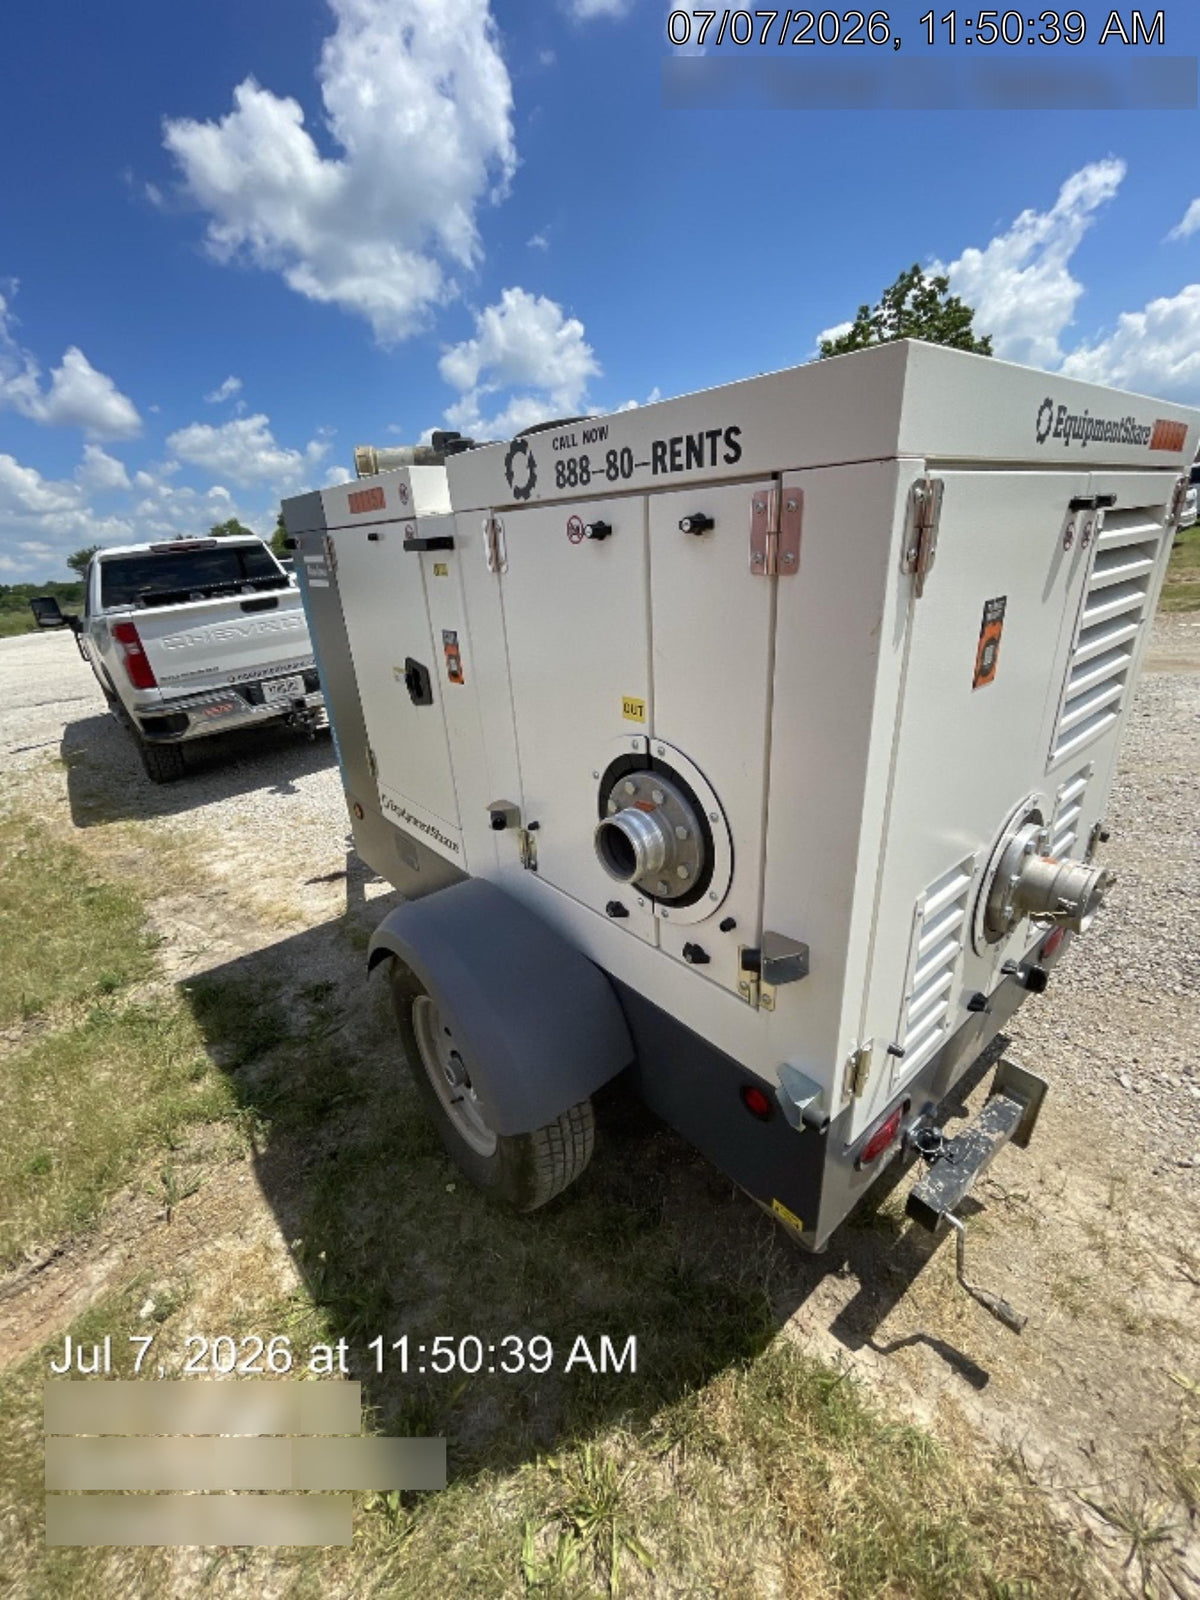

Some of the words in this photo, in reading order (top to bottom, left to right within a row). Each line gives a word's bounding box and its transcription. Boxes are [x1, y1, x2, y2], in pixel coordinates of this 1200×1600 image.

[552, 431, 578, 451] CALL
[582, 424, 609, 445] NOW
[1052, 404, 1152, 447] EquipmentShare
[554, 425, 742, 490] 888-80-RENTS
[623, 701, 645, 718] OUT
